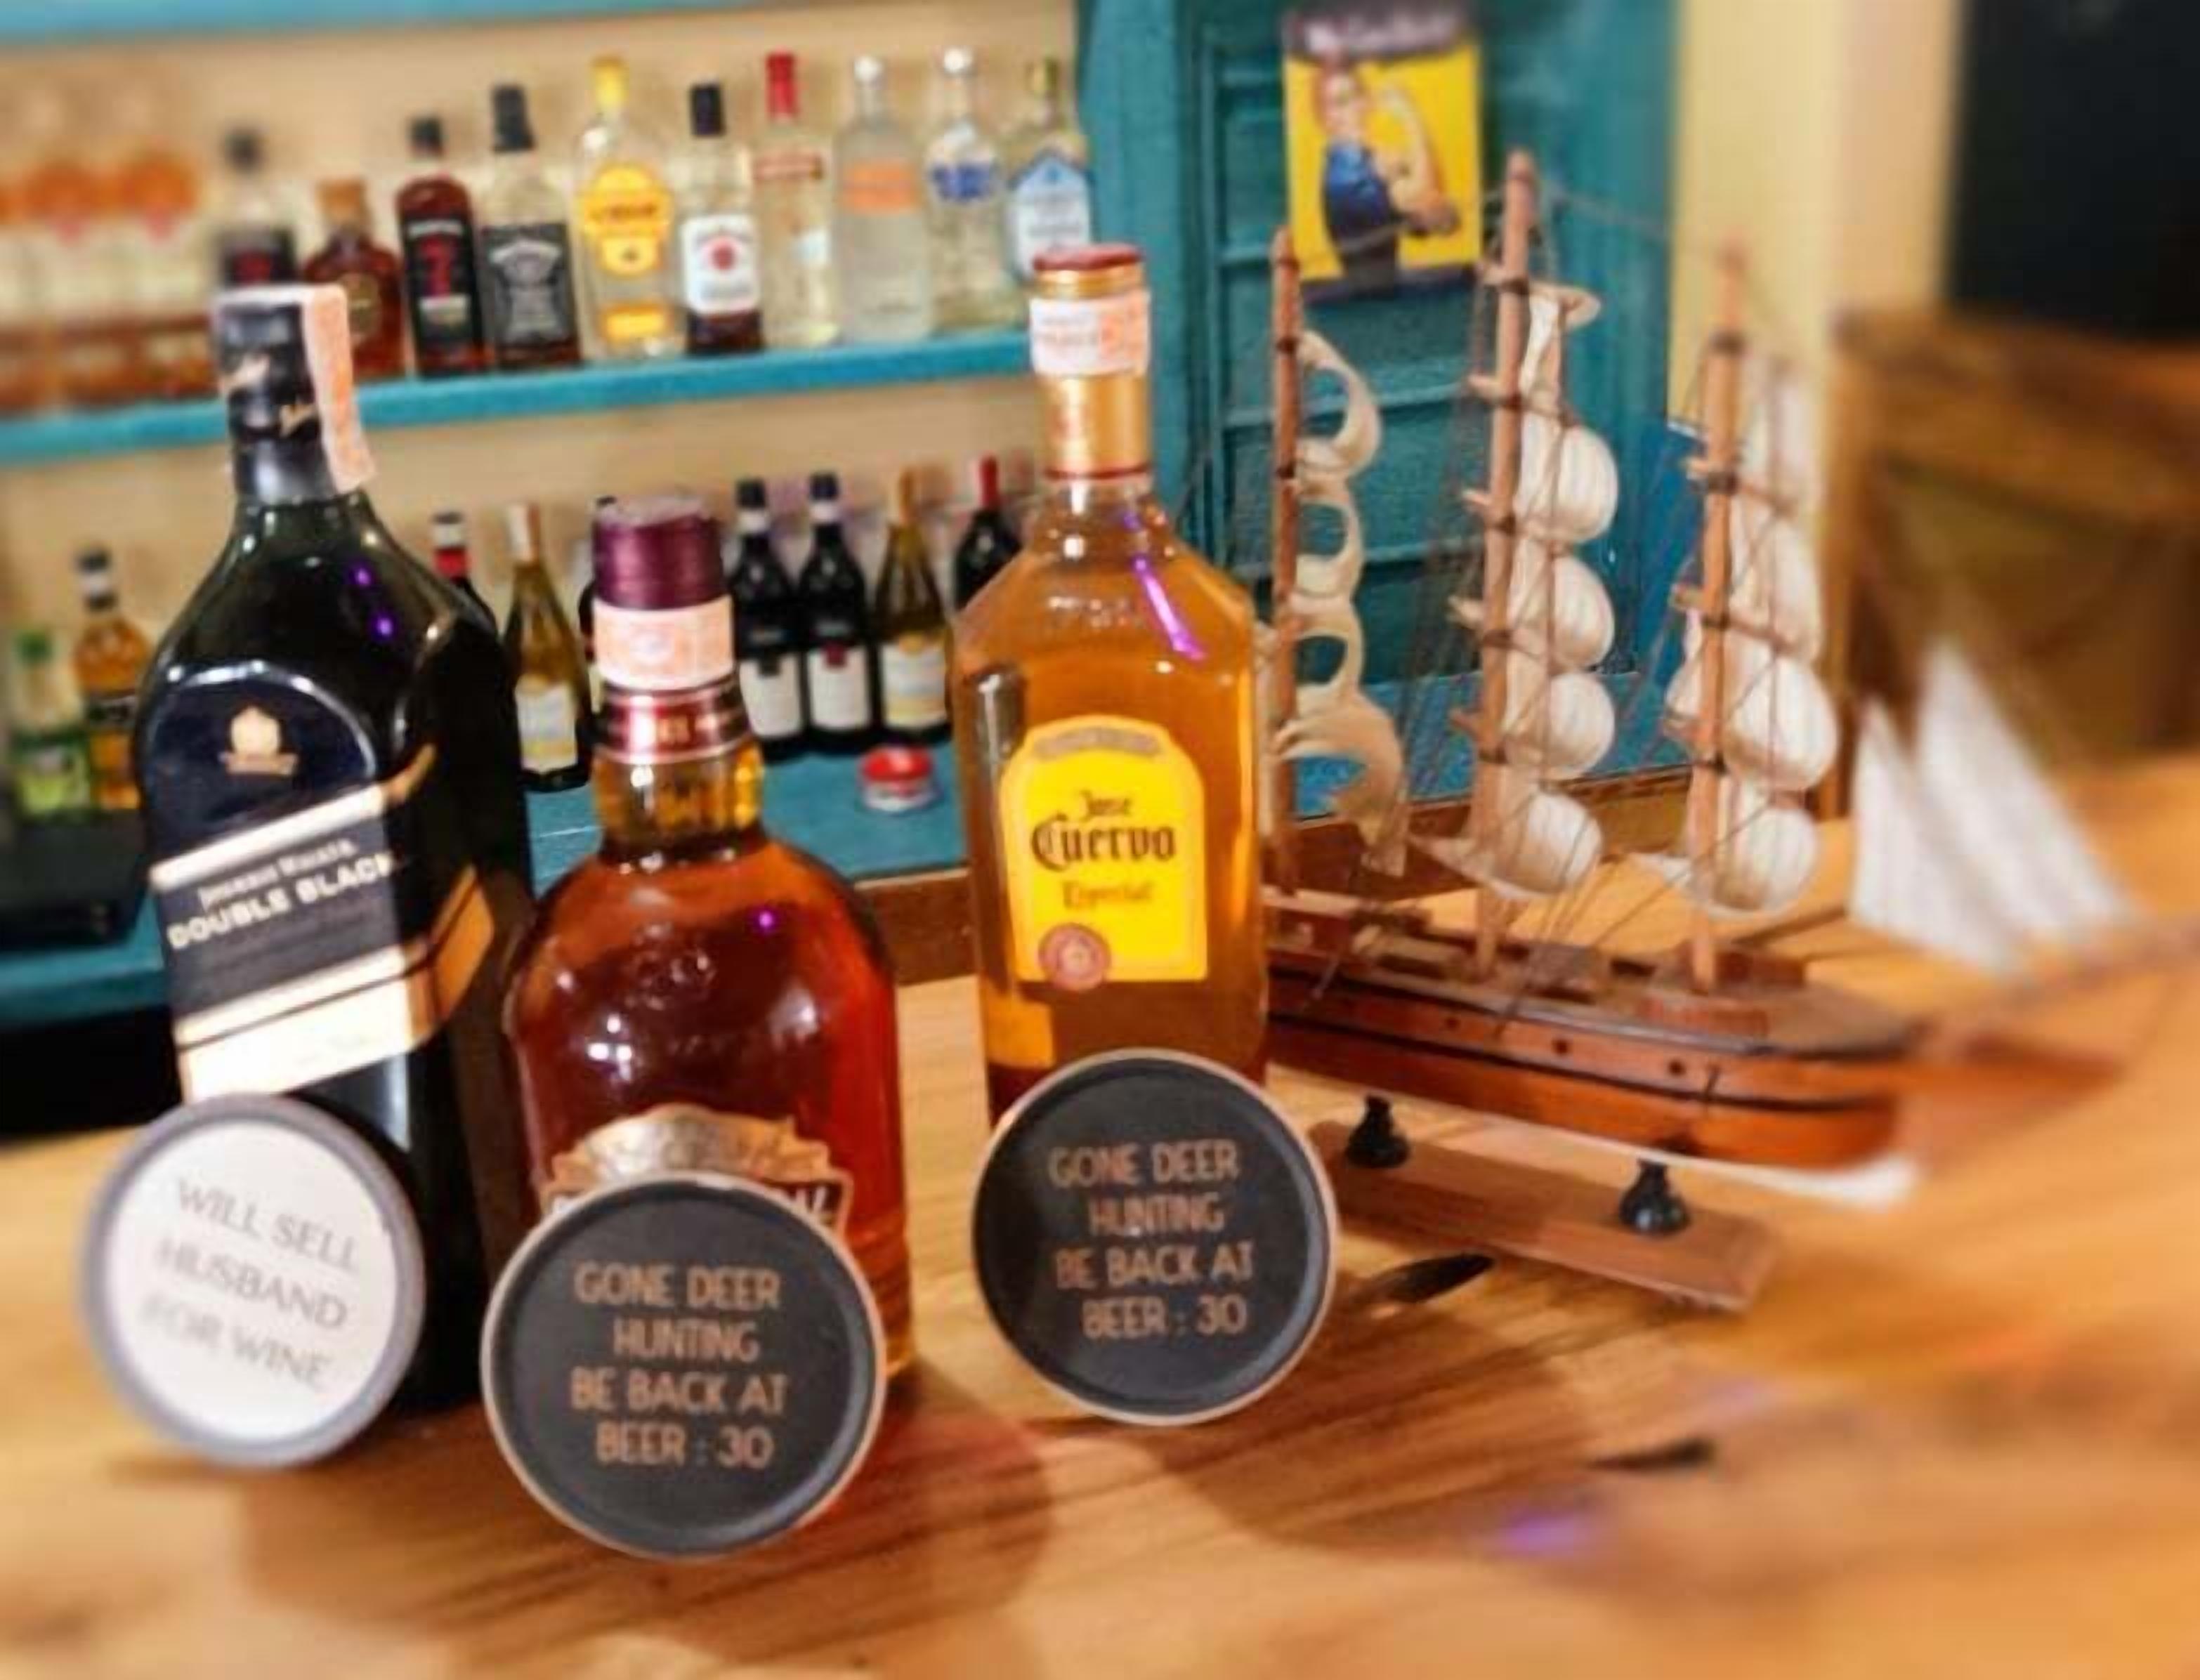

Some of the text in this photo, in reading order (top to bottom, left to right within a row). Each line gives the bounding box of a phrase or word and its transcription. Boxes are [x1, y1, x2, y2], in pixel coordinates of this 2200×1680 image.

[1031, 812, 1175, 872] Cuervo
[167, 887, 291, 949] DOUBLE
[295, 851, 393, 904] BLACK
[1049, 1138, 1240, 1188] GONE DEER
[178, 1175, 360, 1273] WILL SELL
[1087, 1191, 1225, 1237] HUNTING
[156, 1235, 348, 1330] HUSBAND
[574, 1262, 780, 1311] GONE DEER
[1054, 1240, 1255, 1289] BE BACK AT
[613, 1316, 760, 1363] HUNTING
[1082, 1296, 1167, 1339] BEER
[1197, 1294, 1247, 1335] 30
[232, 1326, 334, 1391] WINE
[570, 1366, 788, 1416] BE BACK AT
[596, 1420, 687, 1466] BEER
[717, 1426, 773, 1469] 30
